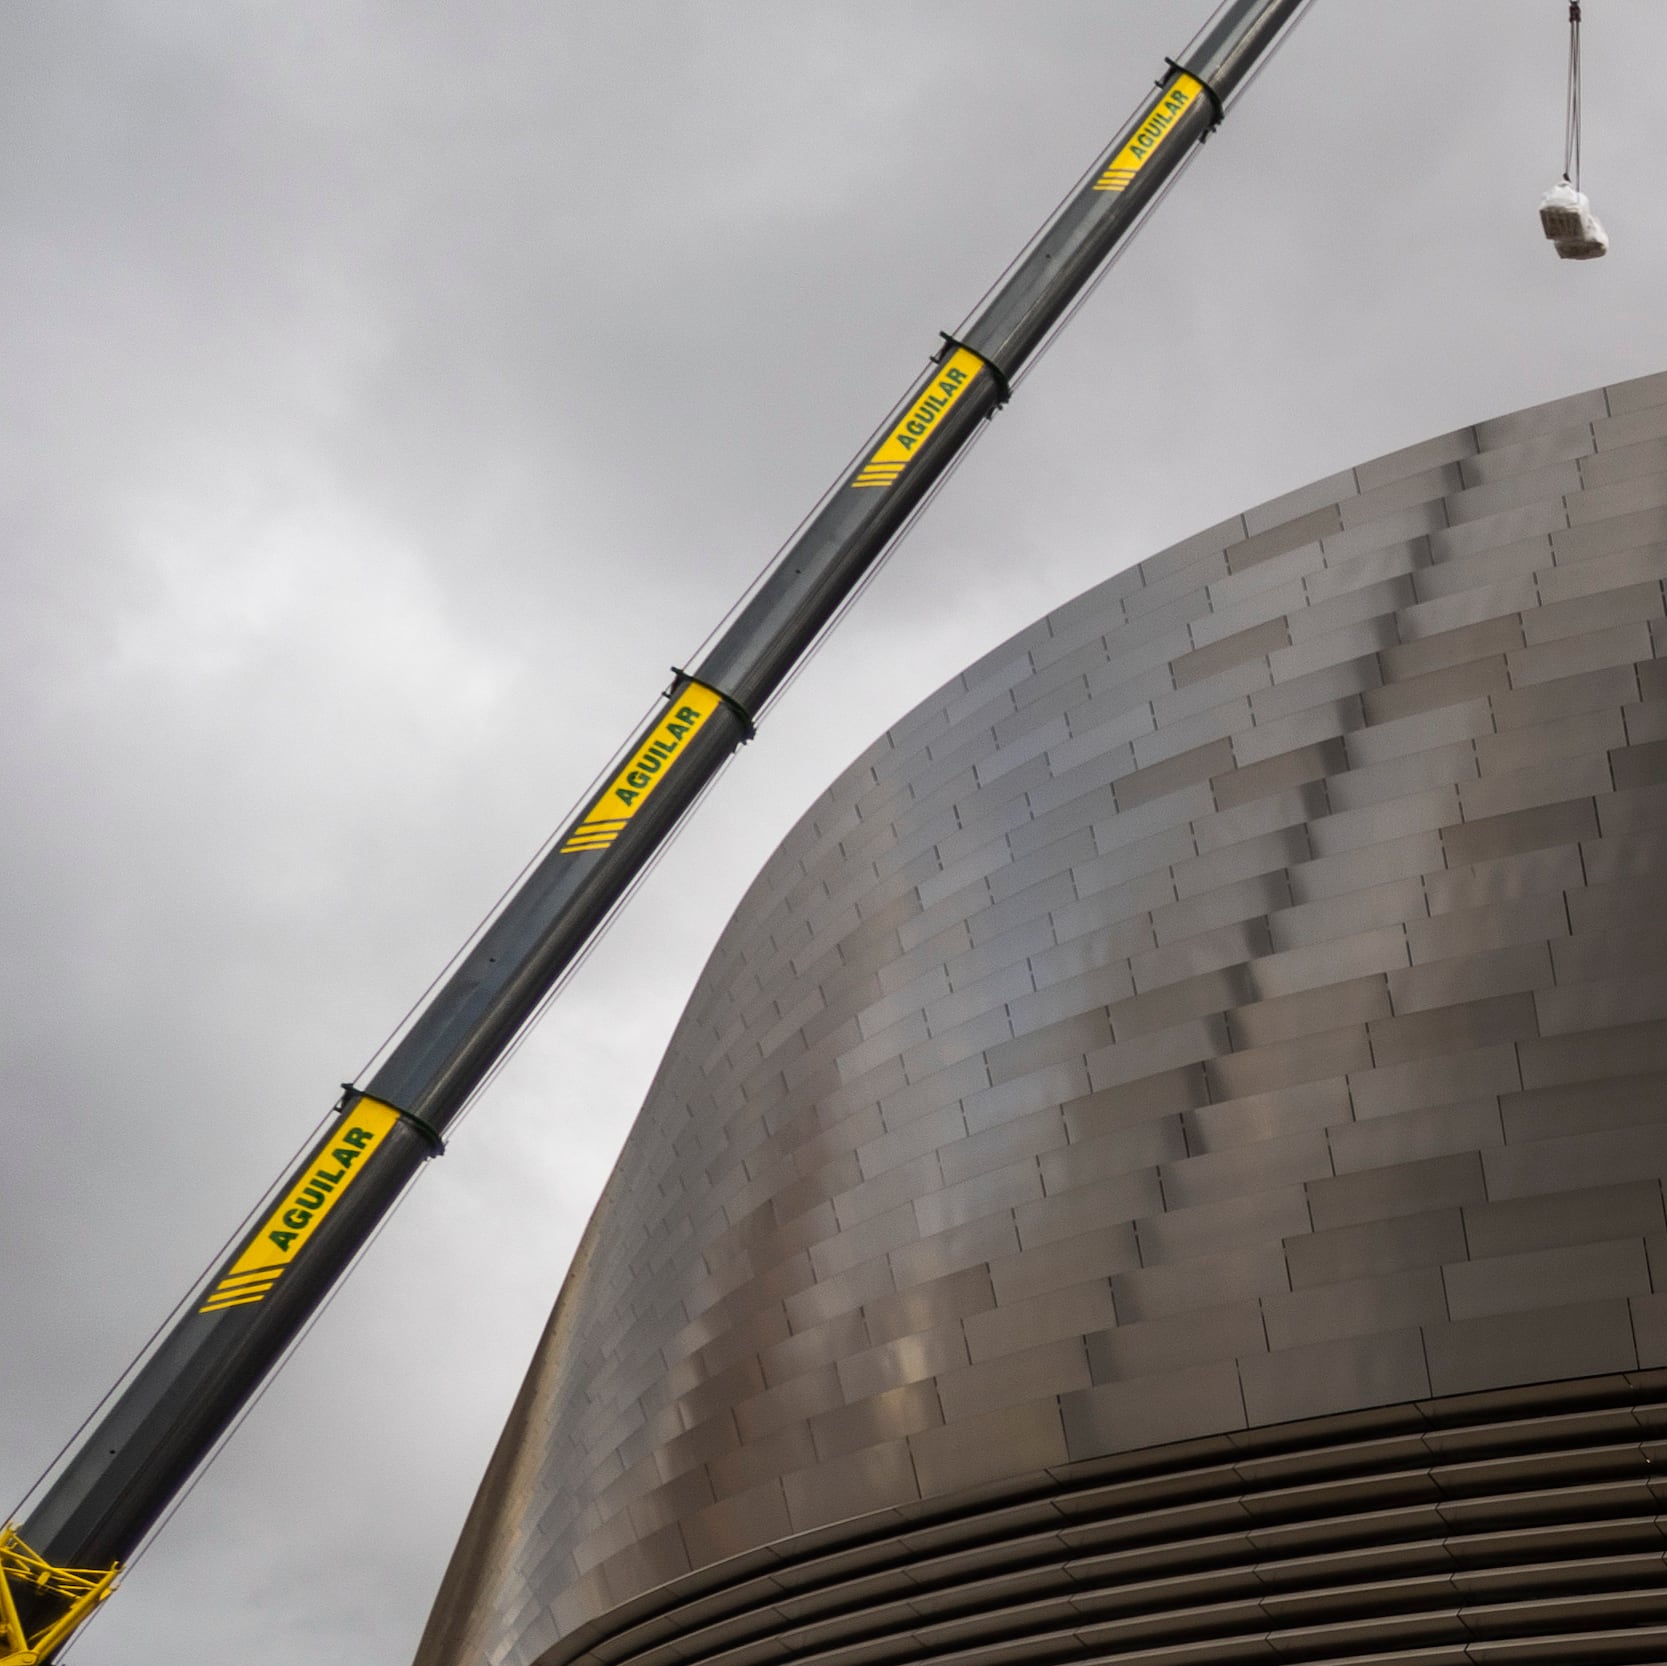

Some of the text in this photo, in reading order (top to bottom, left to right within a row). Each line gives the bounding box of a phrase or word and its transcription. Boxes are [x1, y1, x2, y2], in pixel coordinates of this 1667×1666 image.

[1129, 89, 1189, 160] AGUILAR
[896, 367, 968, 451] AGUILAR
[615, 706, 701, 807] AGUILAR
[268, 1127, 375, 1253] AGUILAR
